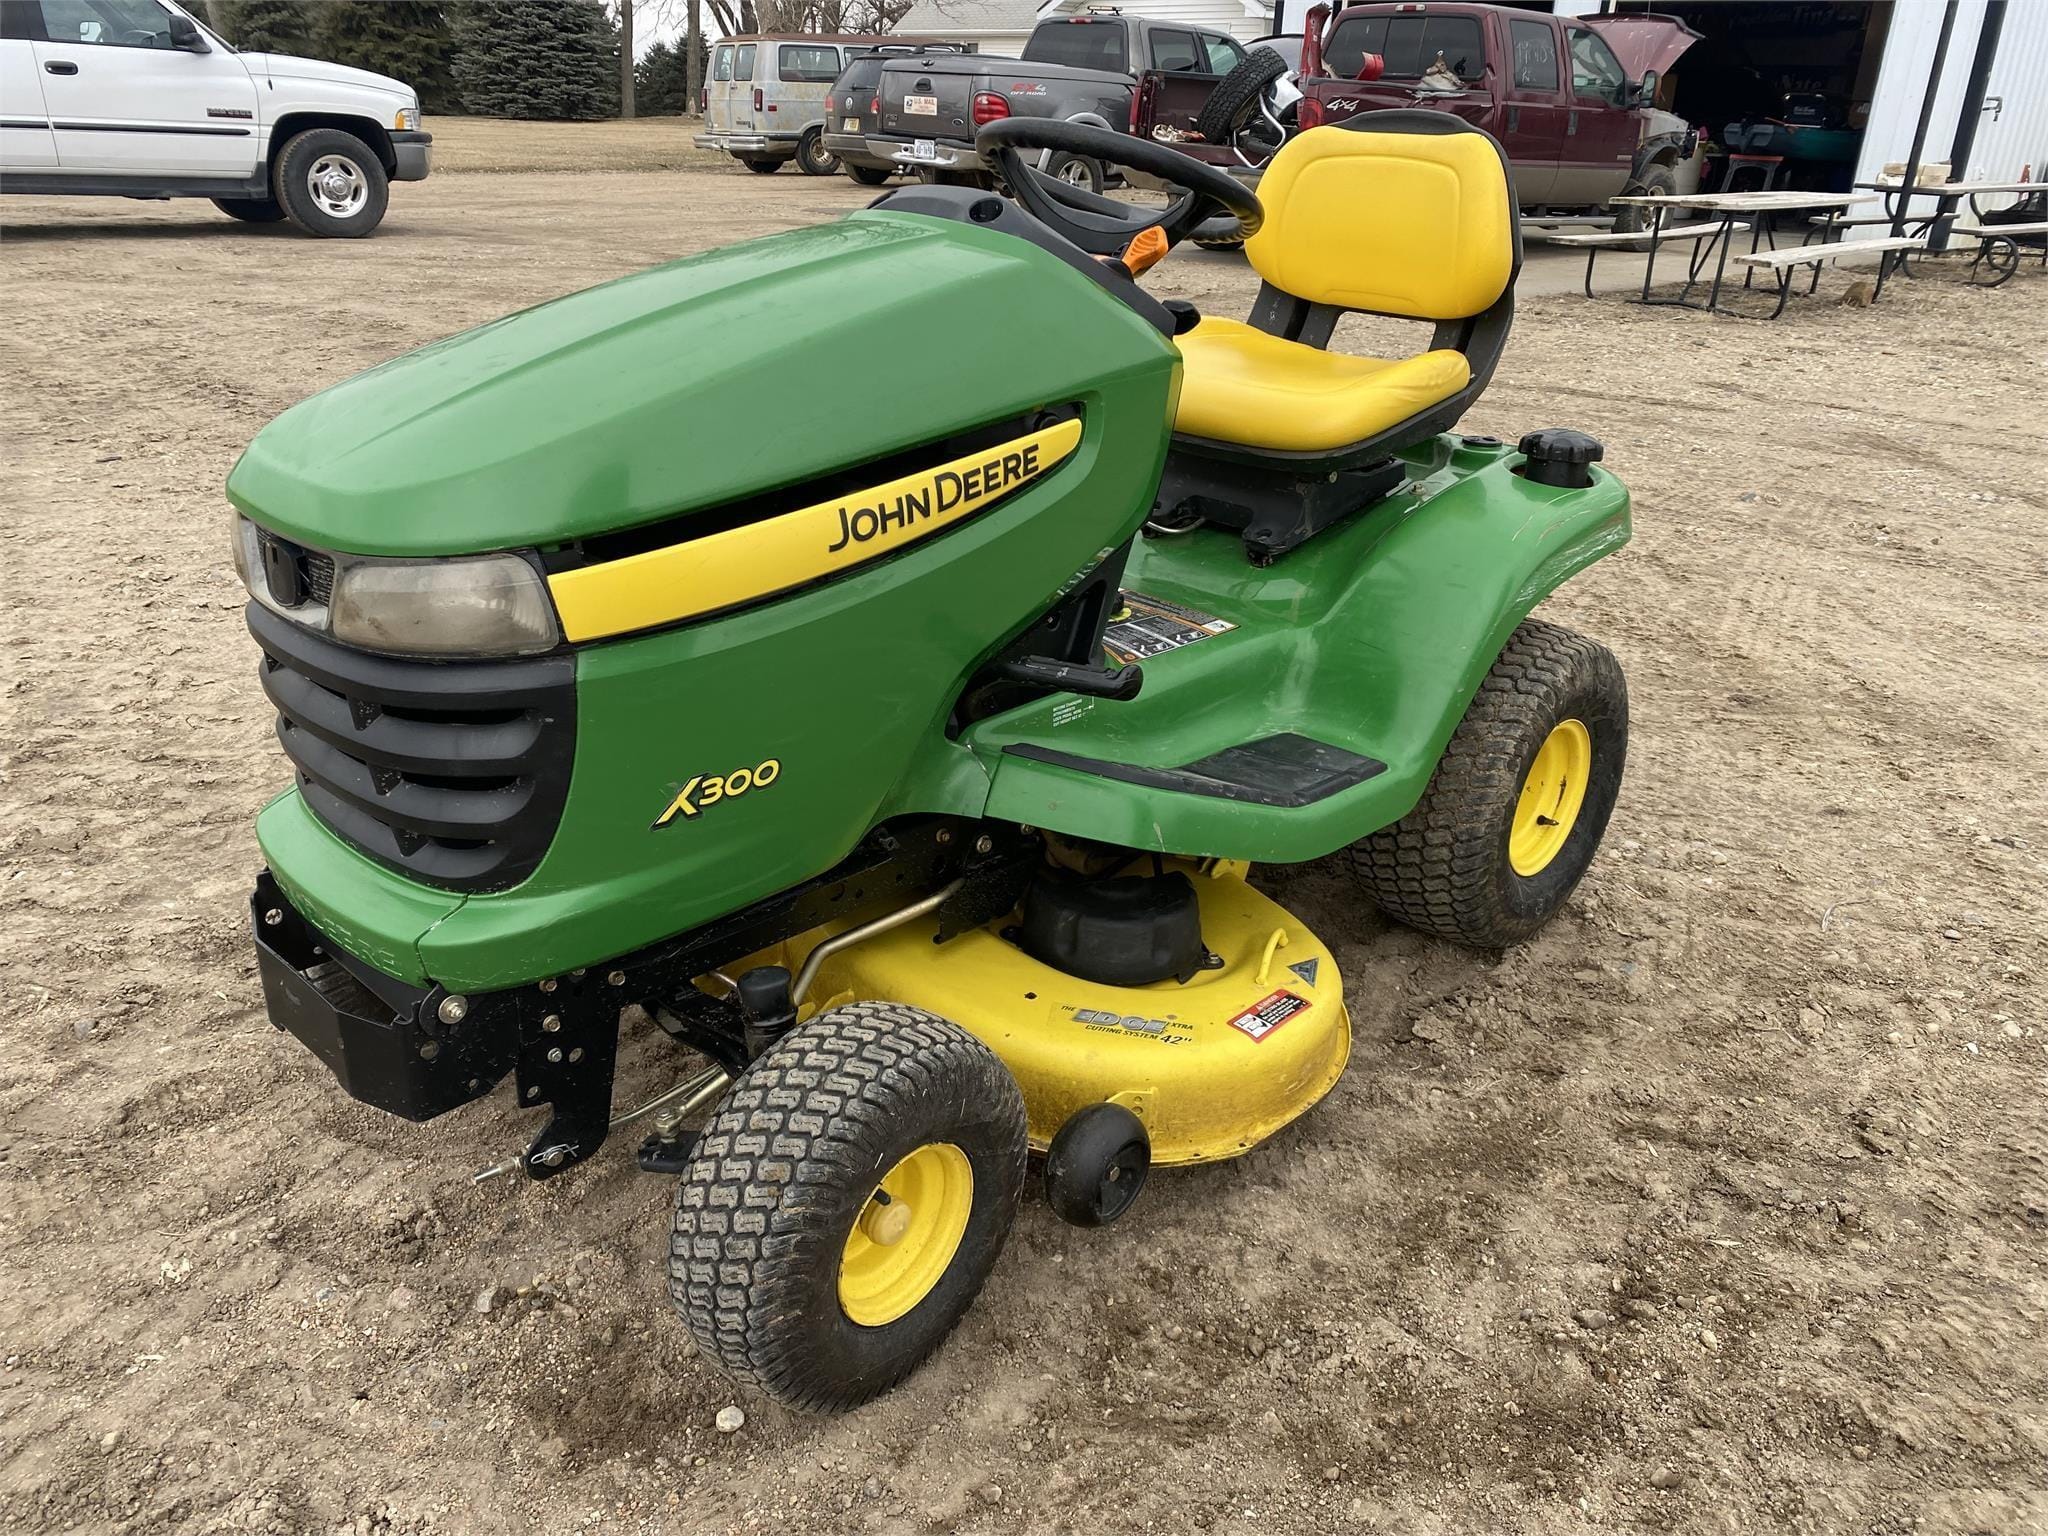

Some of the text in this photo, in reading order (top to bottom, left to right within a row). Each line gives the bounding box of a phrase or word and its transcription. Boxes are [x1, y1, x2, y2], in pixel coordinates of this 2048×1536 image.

[829, 443, 1039, 553] JOHN DEERE
[652, 759, 781, 828] X300
[1071, 1008, 1168, 1034] EDGE
[1085, 1024, 1192, 1045] CUTTING SYSTEM 42"
